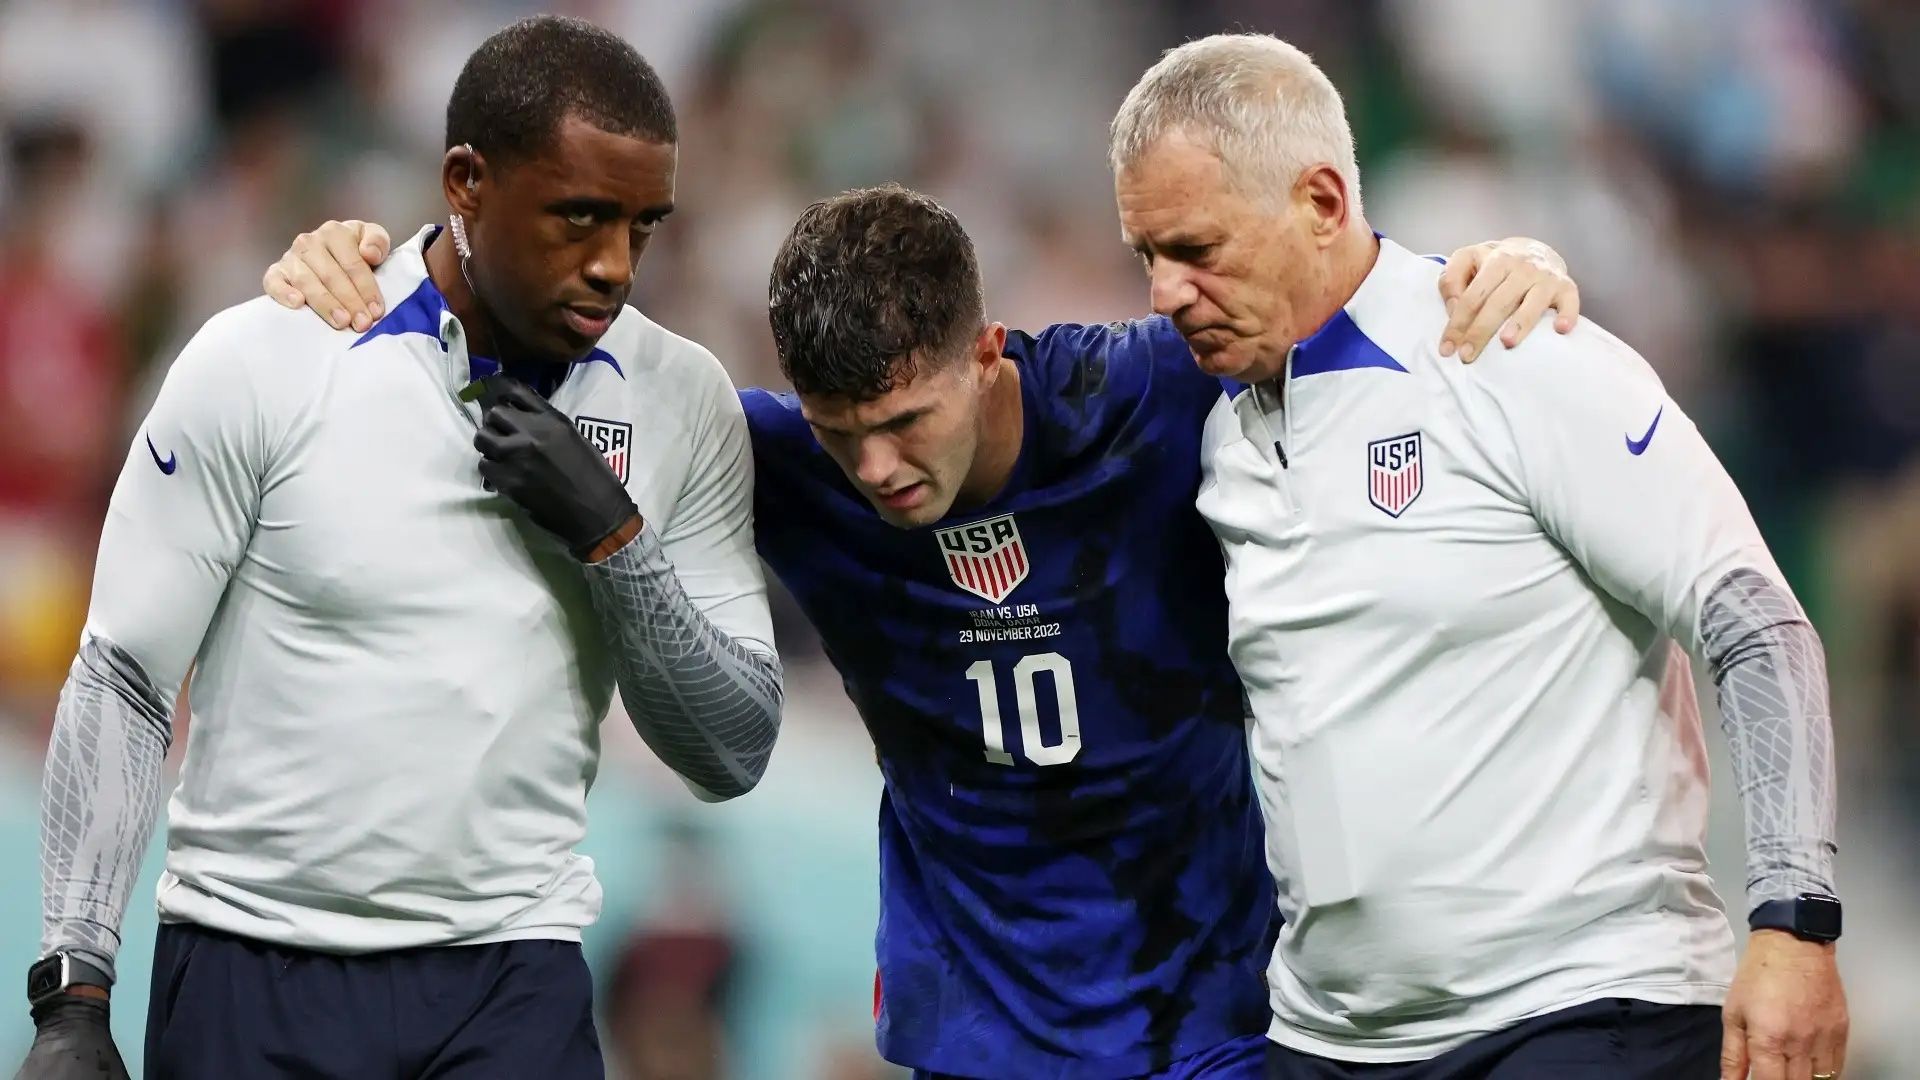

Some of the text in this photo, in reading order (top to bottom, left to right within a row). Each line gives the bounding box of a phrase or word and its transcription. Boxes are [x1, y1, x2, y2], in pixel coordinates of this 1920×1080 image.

[581, 423, 626, 454] USA
[1374, 439, 1417, 471] USA
[941, 519, 1015, 554] USA
[969, 604, 1039, 620] IRAN VS. USA
[1006, 616, 1041, 627] QATAR
[959, 622, 1061, 643] 29 NOVEMBER 2022
[965, 652, 1082, 767] 10
